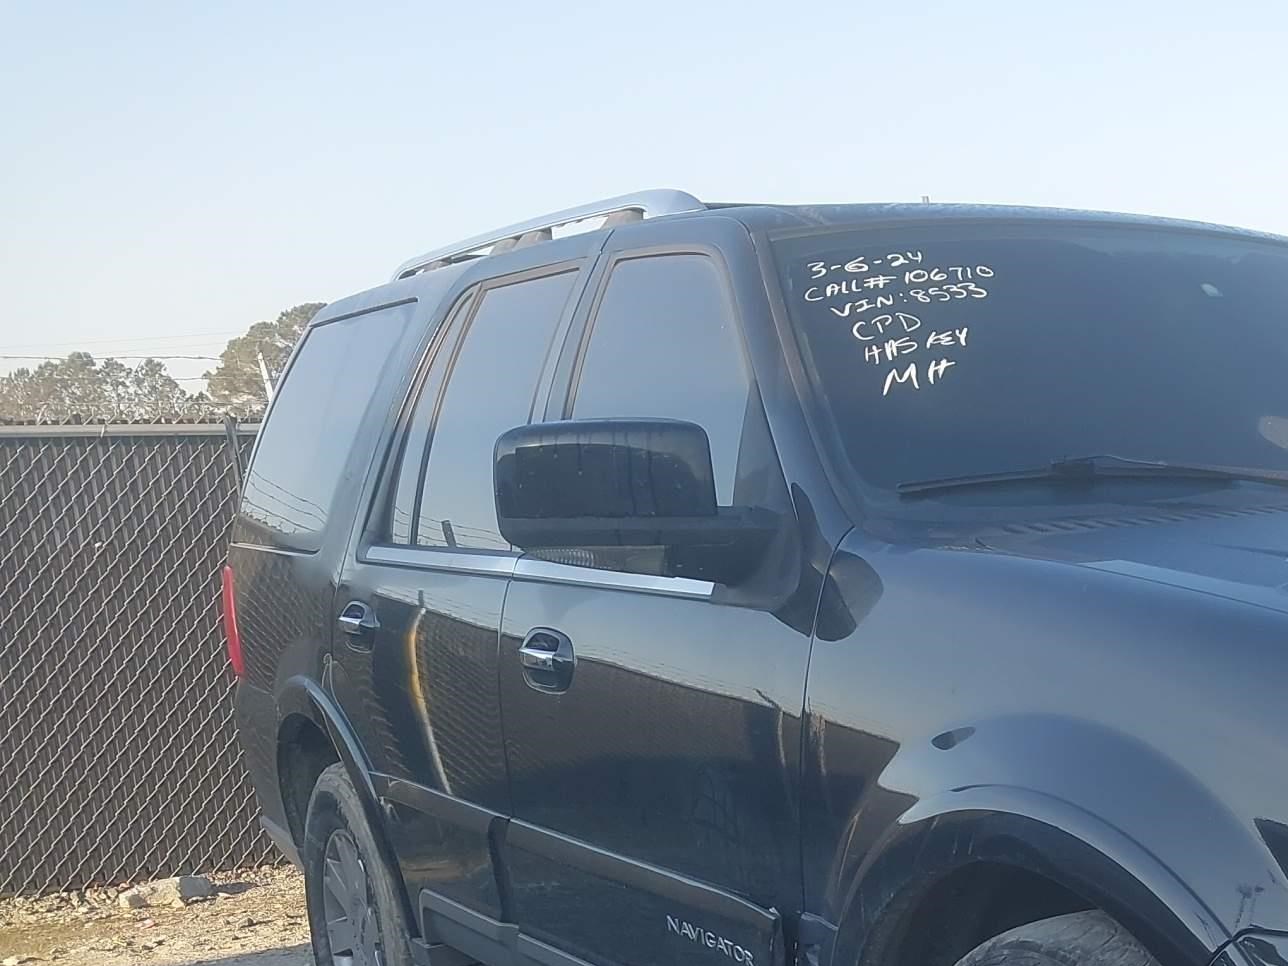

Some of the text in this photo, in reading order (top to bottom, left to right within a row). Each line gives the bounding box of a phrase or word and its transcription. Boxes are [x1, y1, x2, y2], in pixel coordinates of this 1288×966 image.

[807, 251, 923, 278] 3-6-24
[904, 265, 994, 284] 106710
[852, 312, 921, 340] CPD
[864, 327, 969, 364] HAS KEY
